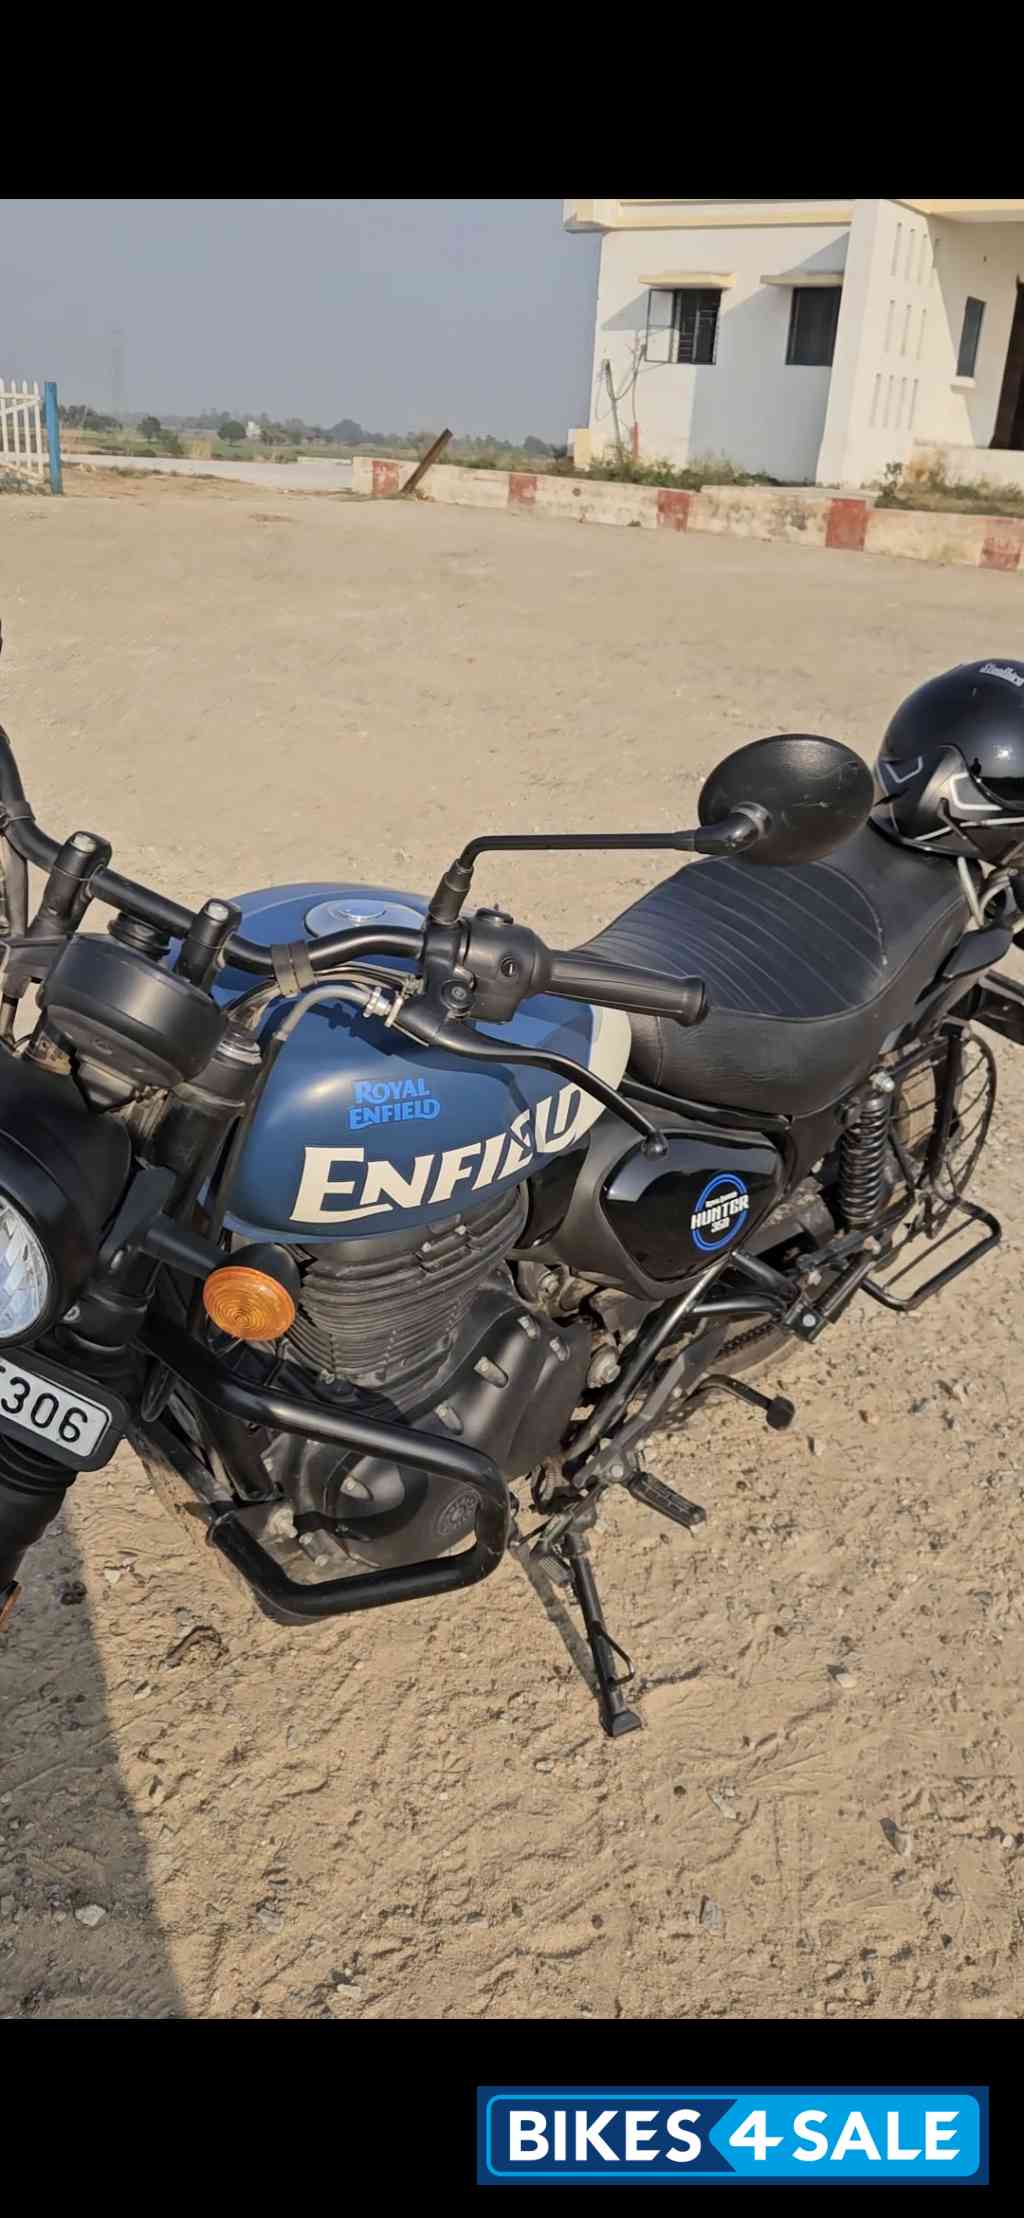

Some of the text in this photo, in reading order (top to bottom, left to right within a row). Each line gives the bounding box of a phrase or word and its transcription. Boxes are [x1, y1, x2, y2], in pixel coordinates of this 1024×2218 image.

[353, 1078, 431, 1104] ROYAL
[348, 1098, 441, 1130] ENFIELD
[289, 1082, 606, 1224] ENFIELD
[690, 1194, 749, 1230] HUNTER
[0, 1364, 88, 1443] 306
